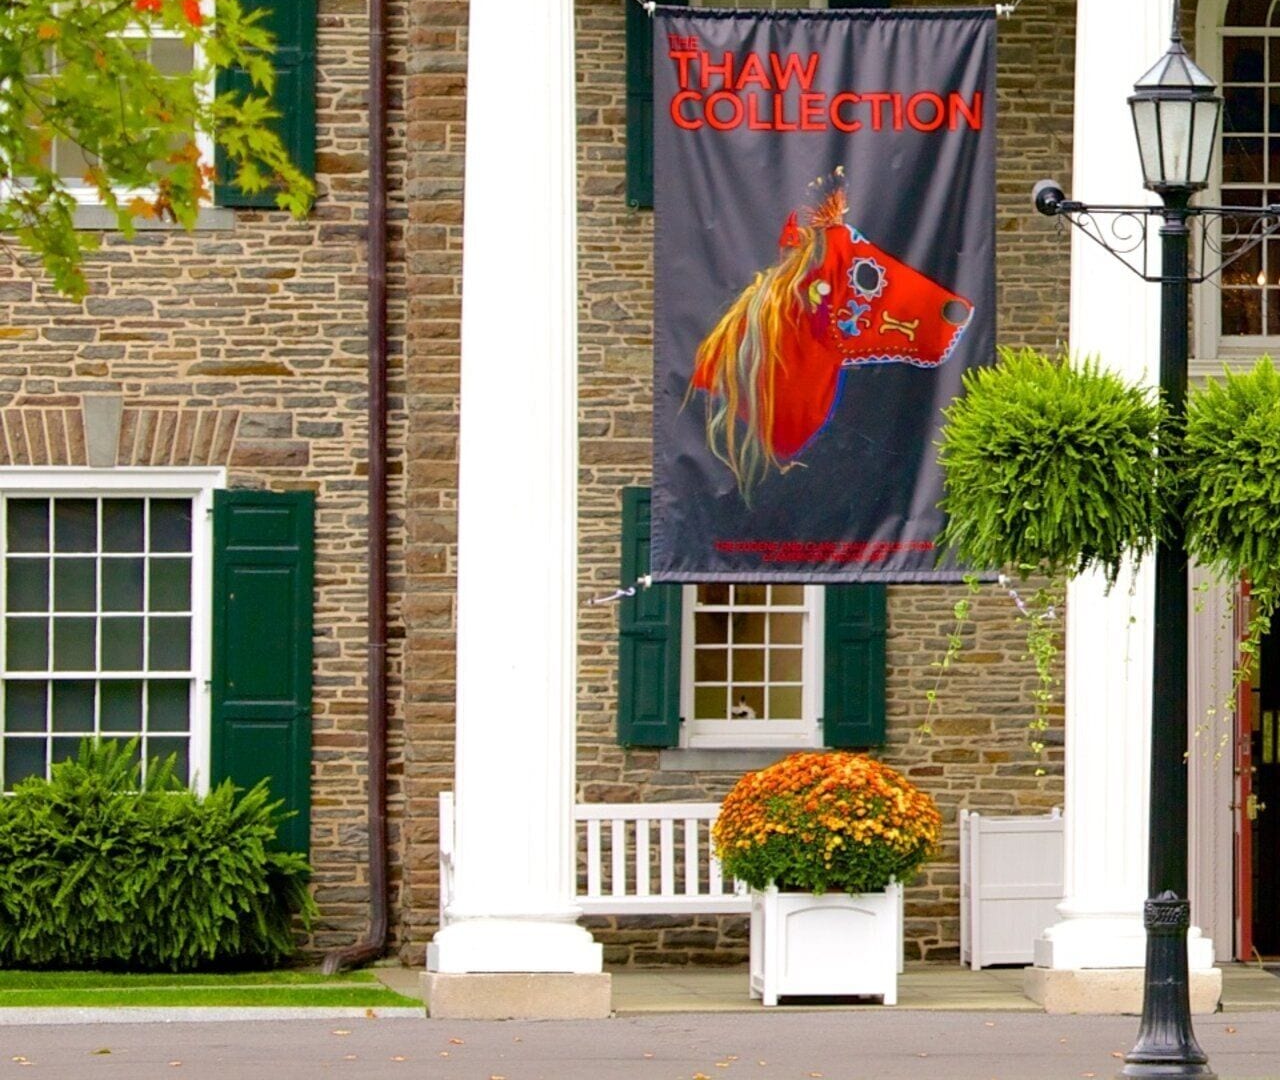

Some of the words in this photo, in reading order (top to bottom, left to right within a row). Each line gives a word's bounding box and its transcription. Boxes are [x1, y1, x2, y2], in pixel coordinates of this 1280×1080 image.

[668, 34, 699, 50] THE
[669, 51, 820, 91] THAW
[670, 90, 984, 133] COLLECTION
